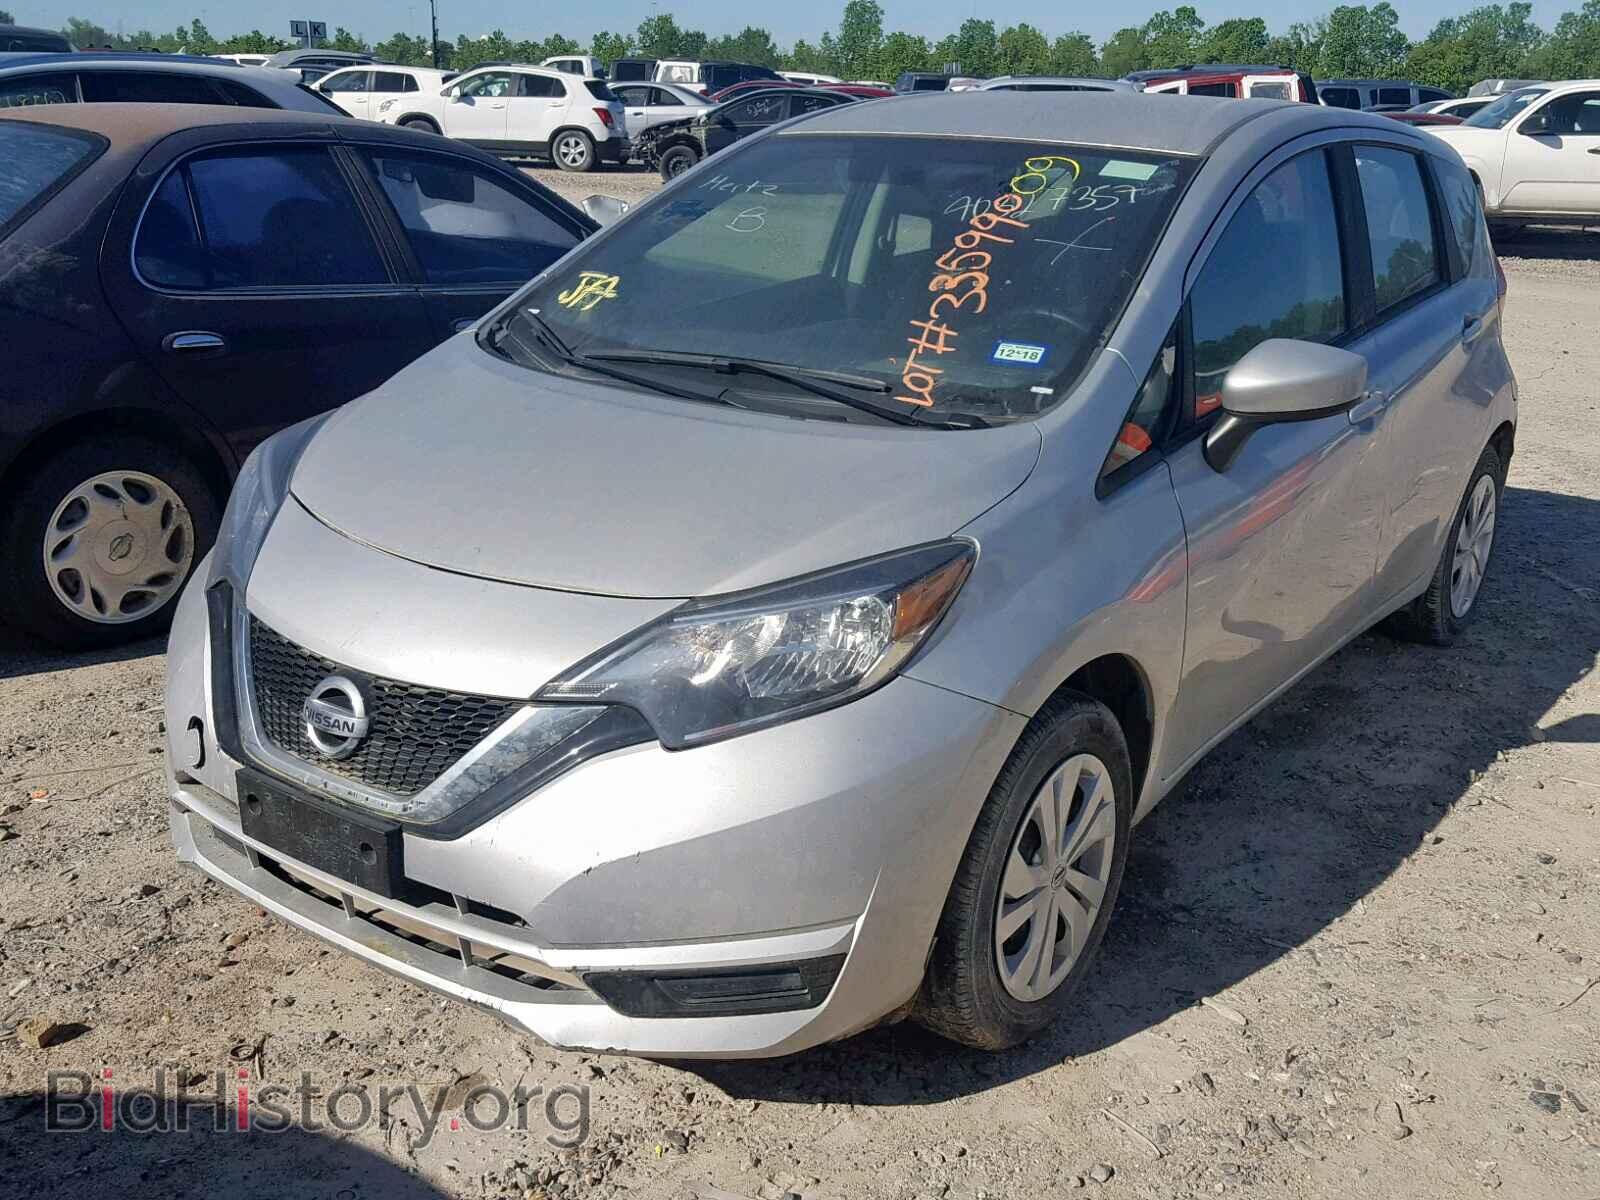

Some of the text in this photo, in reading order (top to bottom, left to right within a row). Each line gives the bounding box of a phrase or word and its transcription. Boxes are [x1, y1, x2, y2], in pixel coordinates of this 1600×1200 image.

[295, 24, 304, 35] L
[313, 24, 321, 36] K
[698, 175, 778, 197] Hertz
[725, 206, 768, 232] B
[306, 705, 355, 733] NISSAN
